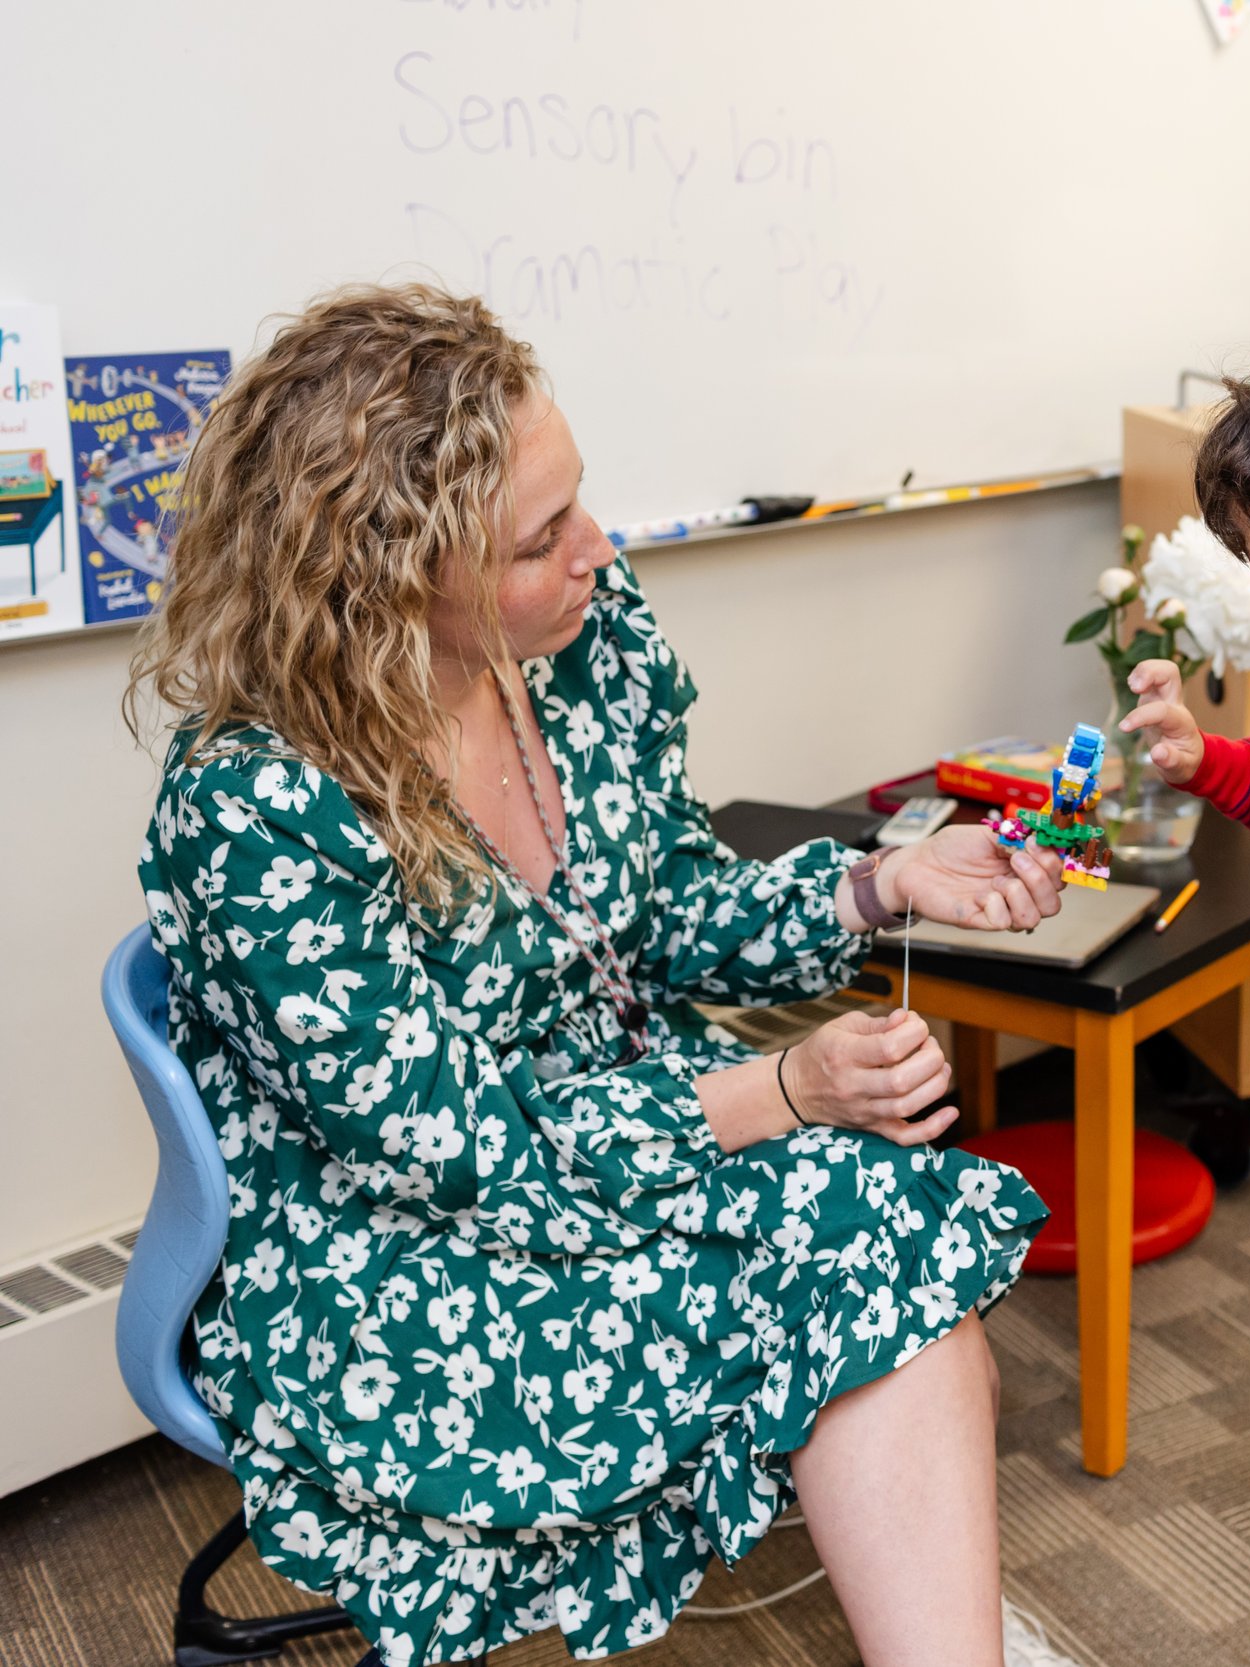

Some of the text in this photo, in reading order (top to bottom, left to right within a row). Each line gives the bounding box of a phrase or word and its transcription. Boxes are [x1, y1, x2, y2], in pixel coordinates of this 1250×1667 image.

[393, 50, 838, 229] Sensory bin
[404, 202, 731, 322] Dramatic
[95, 418, 129, 443] YOU
